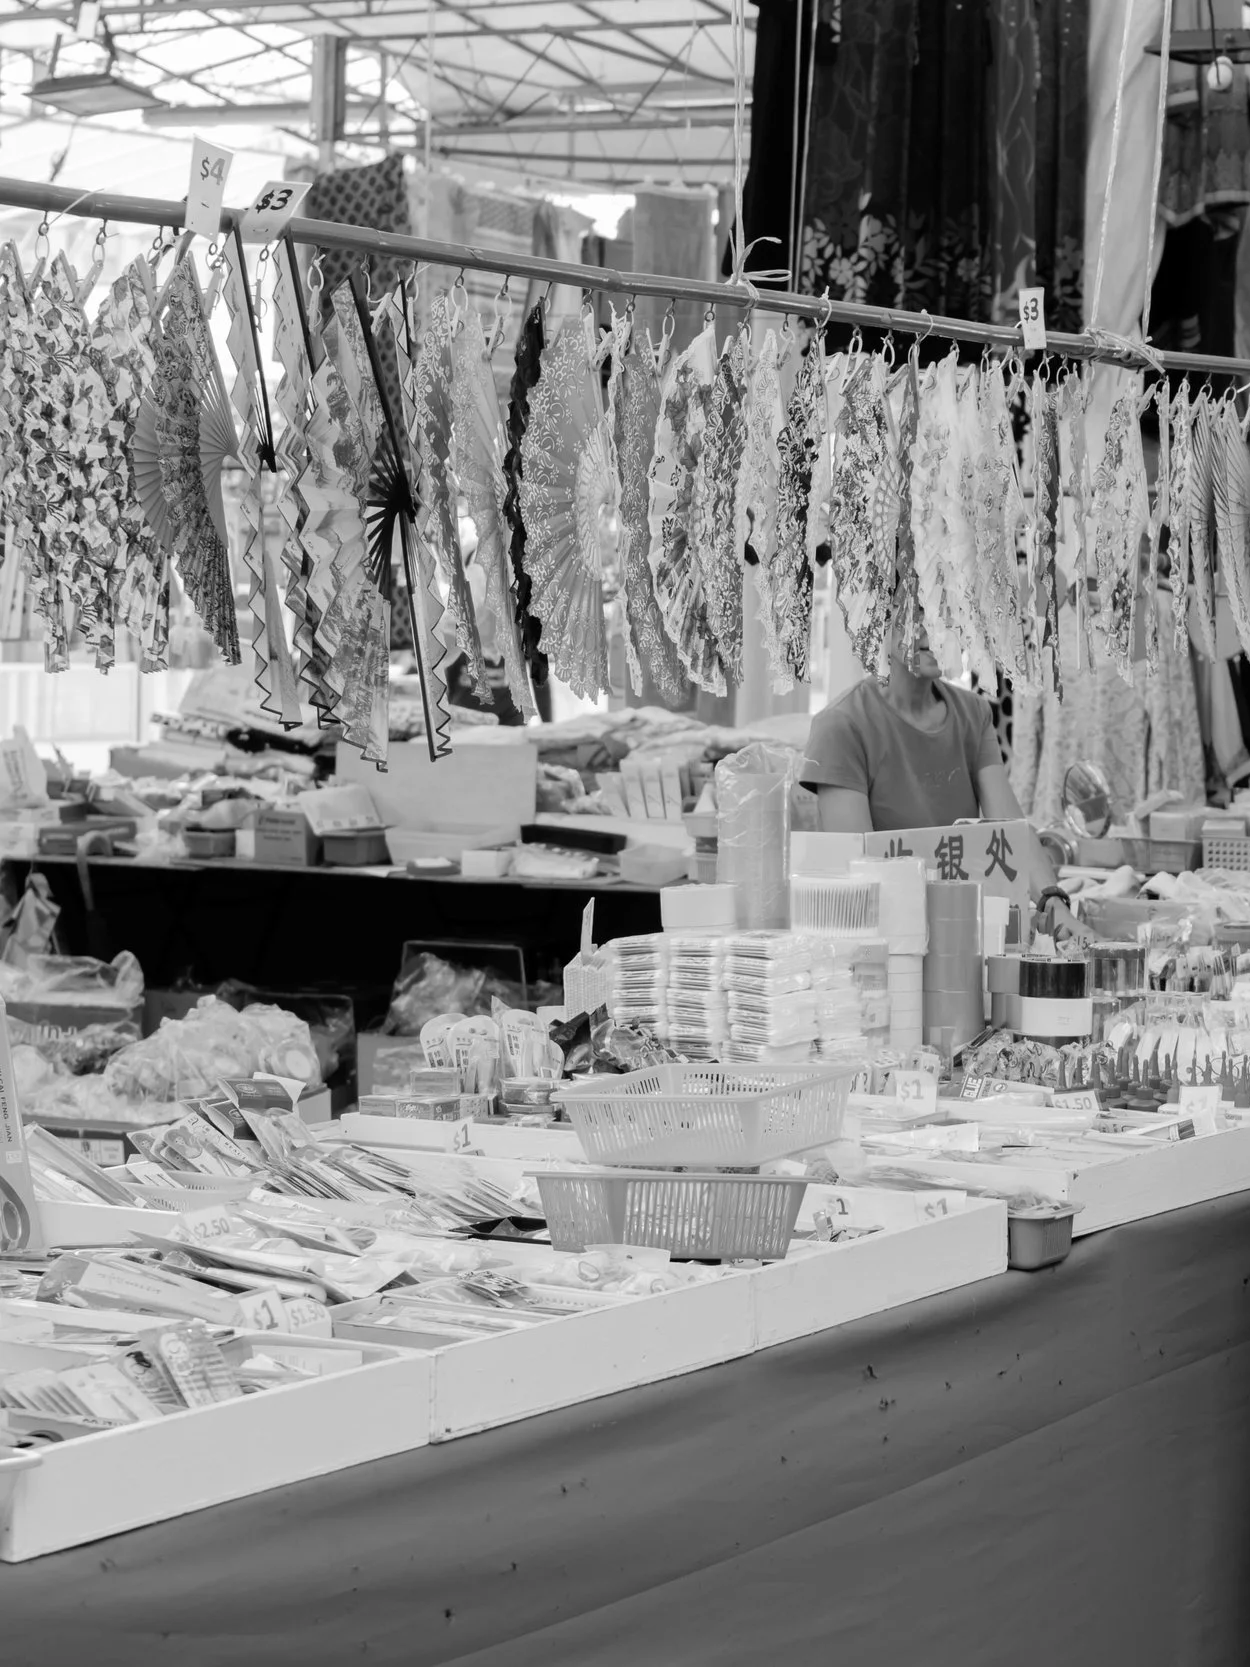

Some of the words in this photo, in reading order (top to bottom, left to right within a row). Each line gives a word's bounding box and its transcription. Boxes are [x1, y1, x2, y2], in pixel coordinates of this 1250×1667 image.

[200, 157, 225, 185] $4
[255, 189, 293, 213] $3
[1023, 297, 1039, 324] $3
[901, 1078, 925, 1103] $1
[453, 1123, 471, 1153] $1
[925, 1198, 948, 1219] $1
[193, 1217, 230, 1238] $2.50
[252, 1299, 279, 1330] $1
[290, 1303, 326, 1327] $1.50
